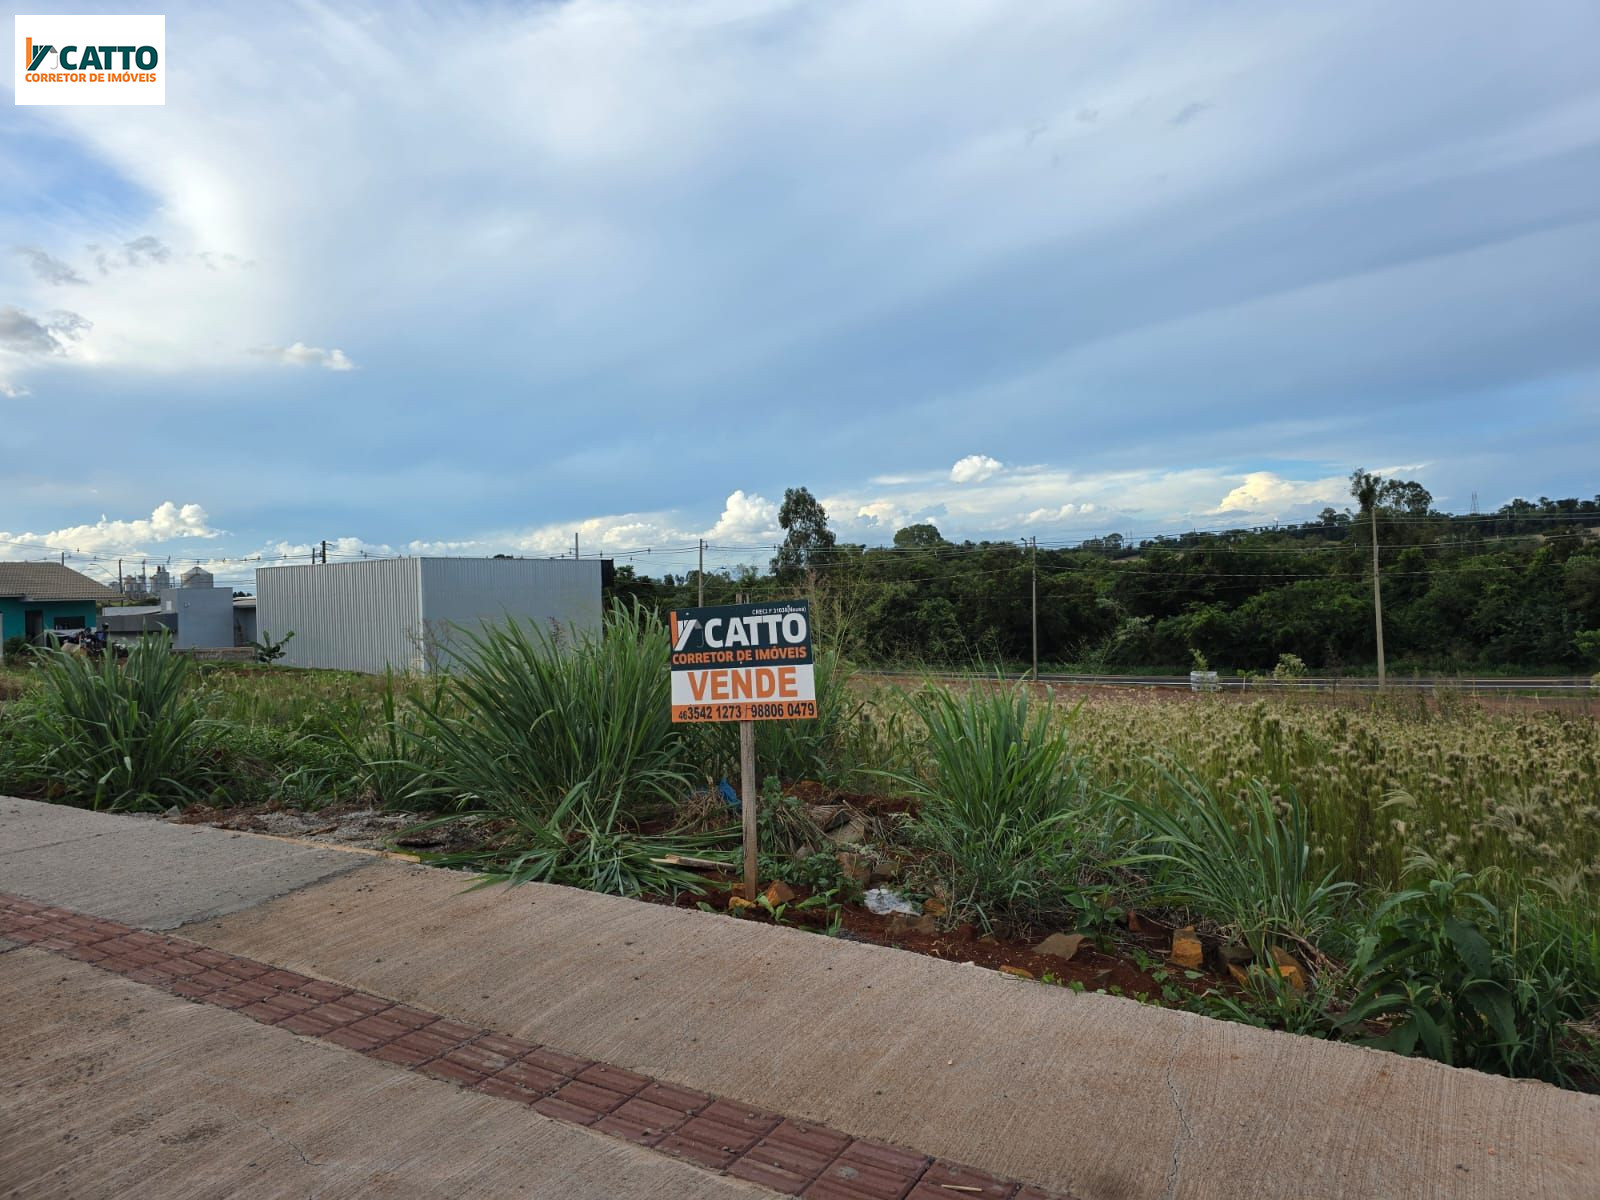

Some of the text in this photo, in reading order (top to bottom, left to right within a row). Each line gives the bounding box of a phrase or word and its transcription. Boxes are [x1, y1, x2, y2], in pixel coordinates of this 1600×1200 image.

[704, 613, 807, 648] CATTO
[672, 646, 807, 665] CORRETOR DE IMÓVEIS
[687, 666, 798, 701] VENDE
[716, 705, 742, 719] 1273
[751, 703, 784, 718] 98806
[787, 702, 815, 717] 0479
